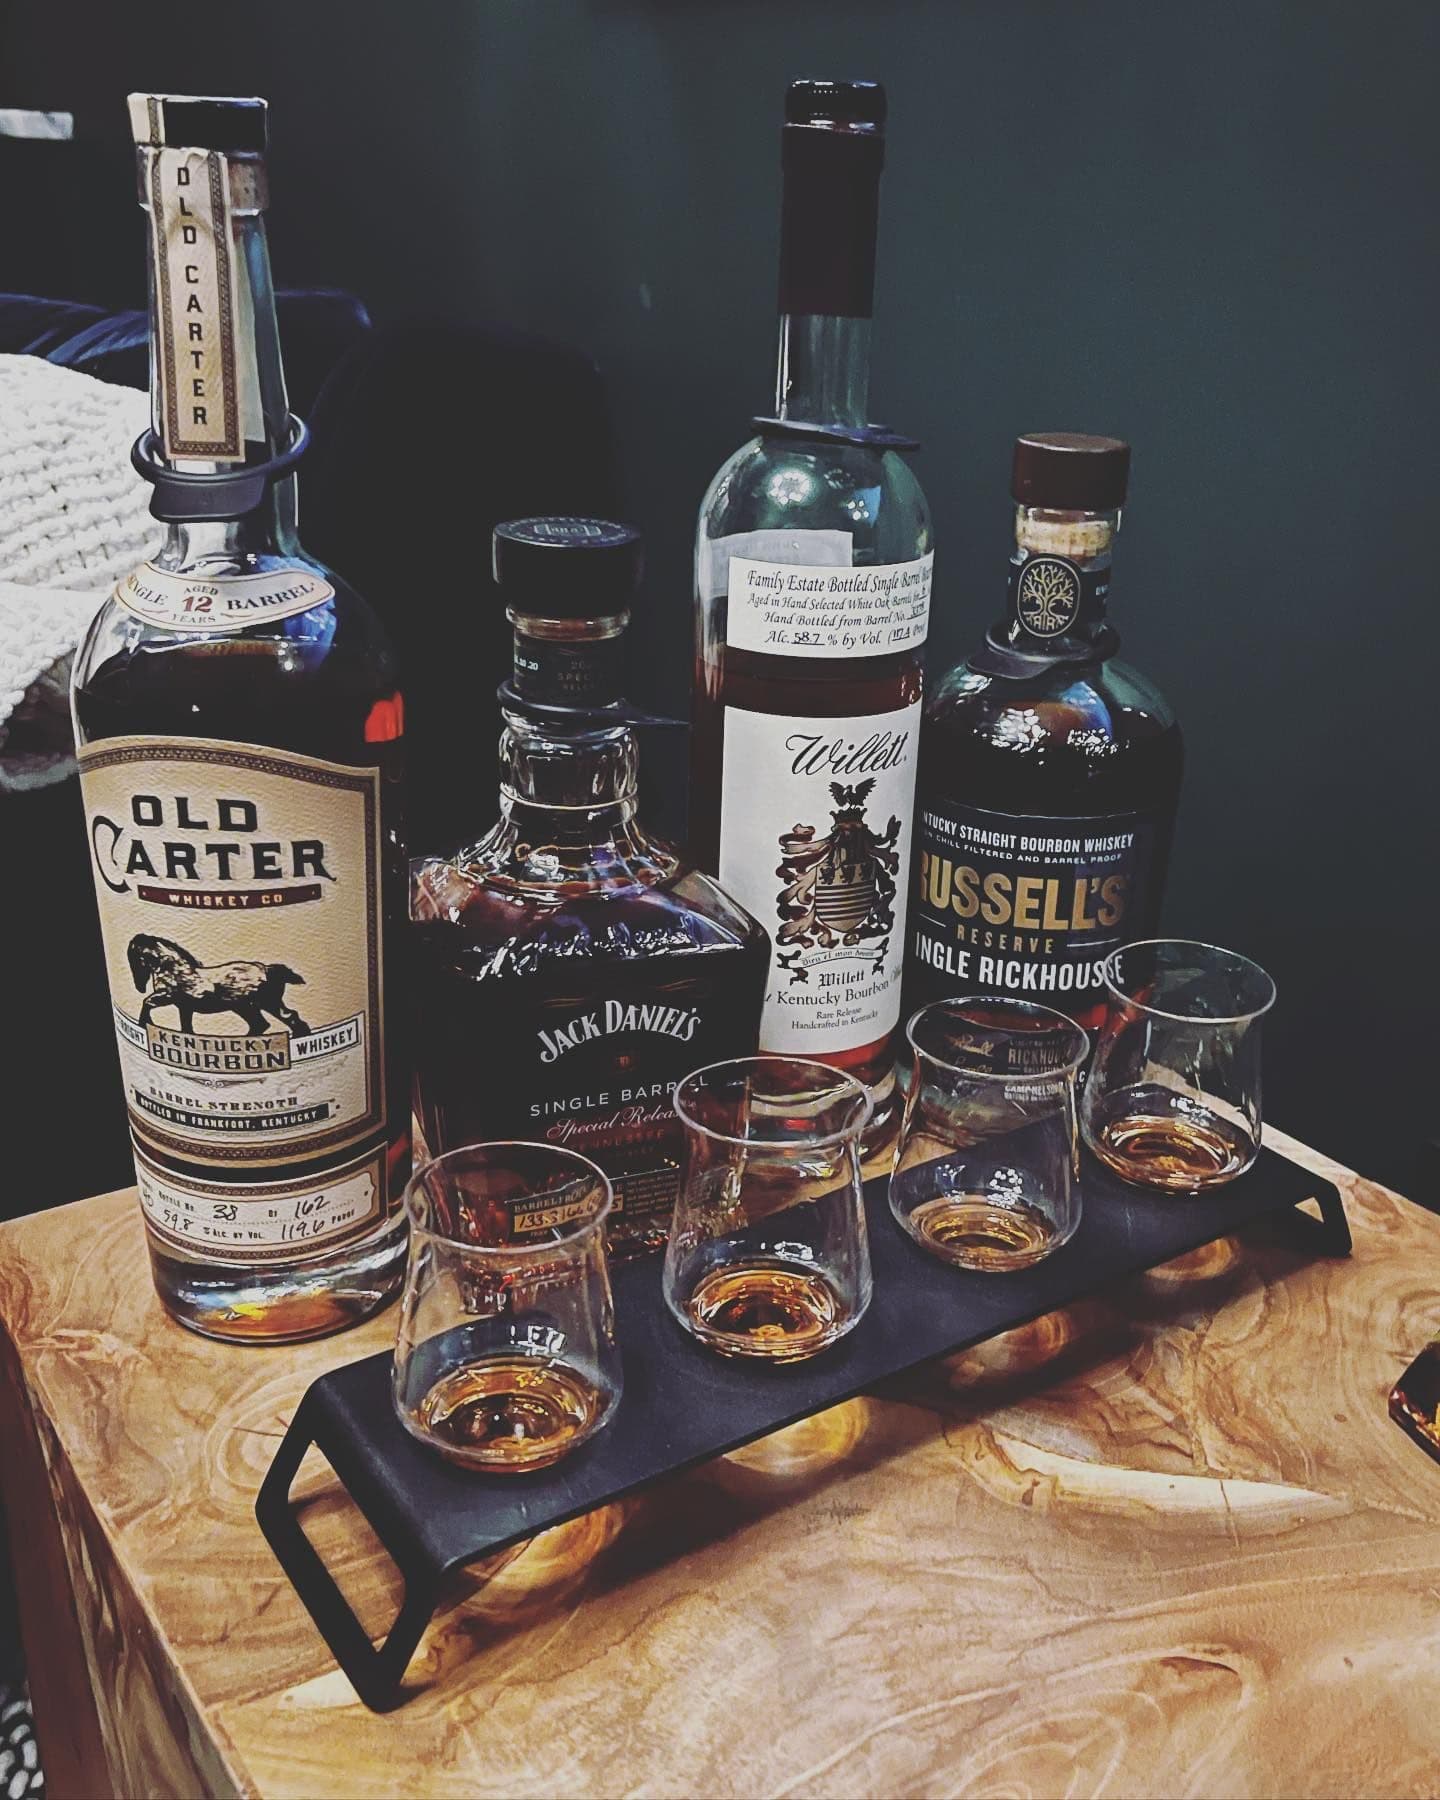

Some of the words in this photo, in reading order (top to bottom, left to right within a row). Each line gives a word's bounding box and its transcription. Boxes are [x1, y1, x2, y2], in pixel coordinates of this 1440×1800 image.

[177, 167, 197, 244] OLD
[184, 264, 208, 425] CARTER
[183, 585, 219, 596] AGED
[747, 569, 785, 595] Family
[787, 574, 825, 592] Estate
[827, 573, 869, 593] Bottled
[871, 571, 898, 595] Single
[183, 596, 213, 613] 12
[227, 583, 314, 611] BARREL
[747, 593, 770, 609] Aged
[781, 596, 807, 609] Hand
[810, 598, 845, 610] Selected
[849, 599, 873, 610] White
[874, 597, 889, 610] Oak
[172, 614, 215, 623] YEARS
[763, 612, 793, 624] Hand
[797, 614, 835, 627] Bottled
[835, 615, 862, 630] from
[864, 610, 892, 625] Barrel
[764, 631, 790, 645] Alc.
[794, 632, 824, 643] 58.7
[827, 634, 838, 646] %
[842, 635, 856, 649] by
[860, 633, 881, 644] Vol.
[131, 794, 258, 833] OLD
[936, 834, 961, 849] CHILL
[964, 844, 1013, 860] FILTERED
[1017, 854, 1040, 863] AND
[1044, 855, 1086, 864] BARREL
[1090, 854, 1122, 863] PROOF
[960, 825, 1017, 849] STRAIGHT
[1020, 836, 1080, 853] BOURBON
[1084, 833, 1134, 853] WHISKEY
[92, 815, 337, 893] CARTER
[169, 894, 250, 907] WHISKEY
[262, 894, 283, 904] CO
[957, 924, 1055, 954] RESERVE
[777, 991, 841, 1007] Kentucky
[845, 979, 890, 1002] Bourbon
[817, 969, 865, 990] Willett
[791, 1020, 841, 1030] Handcrafted
[841, 1019, 849, 1027] in
[816, 1011, 834, 1020] Rare
[836, 1007, 863, 1018] Release
[158, 1031, 273, 1052] KENTUCKY
[296, 1027, 354, 1056] WHISKEY
[537, 1012, 602, 1063] JACK
[604, 999, 702, 1042] DANIEL'S
[151, 1043, 287, 1071] BOURBON
[150, 1086, 202, 1108] BARREL
[208, 1096, 299, 1111] STRENGTH
[530, 1092, 610, 1117] SINGLE
[139, 1097, 172, 1119] BOTTLED
[176, 1110, 187, 1123] IN
[261, 1110, 318, 1129] KENTUCKY
[546, 1111, 622, 1144] Special
[620, 1103, 681, 1127] Releas
[213, 1203, 238, 1221] 38
[295, 1195, 331, 1219] 162
[163, 1209, 194, 1232] 59.8
[281, 1220, 325, 1241] 119.6
[331, 1210, 356, 1225] PROOF
